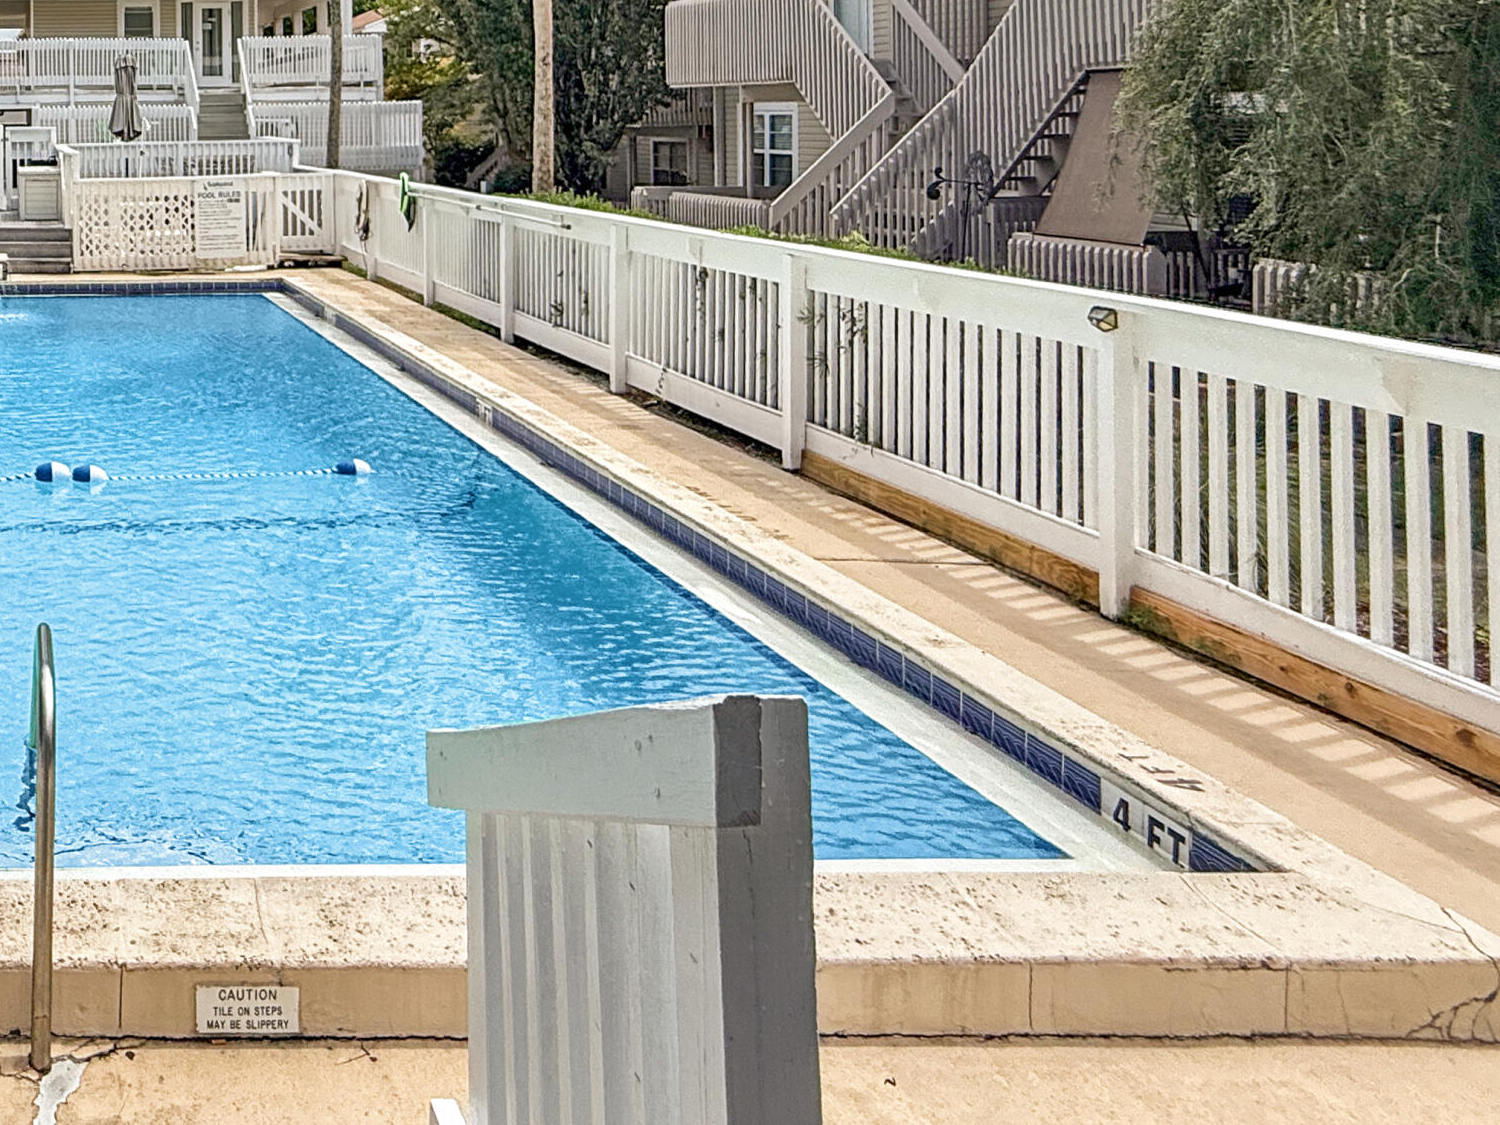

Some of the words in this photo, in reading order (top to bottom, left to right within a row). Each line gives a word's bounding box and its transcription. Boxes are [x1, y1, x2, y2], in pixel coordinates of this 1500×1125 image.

[1113, 797, 1131, 832] 4
[218, 989, 277, 1001] CAUTION
[213, 1006, 233, 1016] TILE
[238, 1006, 250, 1016] ON
[254, 1006, 283, 1016] STEPS
[207, 1020, 226, 1029] MAY
[230, 1020, 241, 1029] BE
[246, 1020, 289, 1030] SLIPPERY
